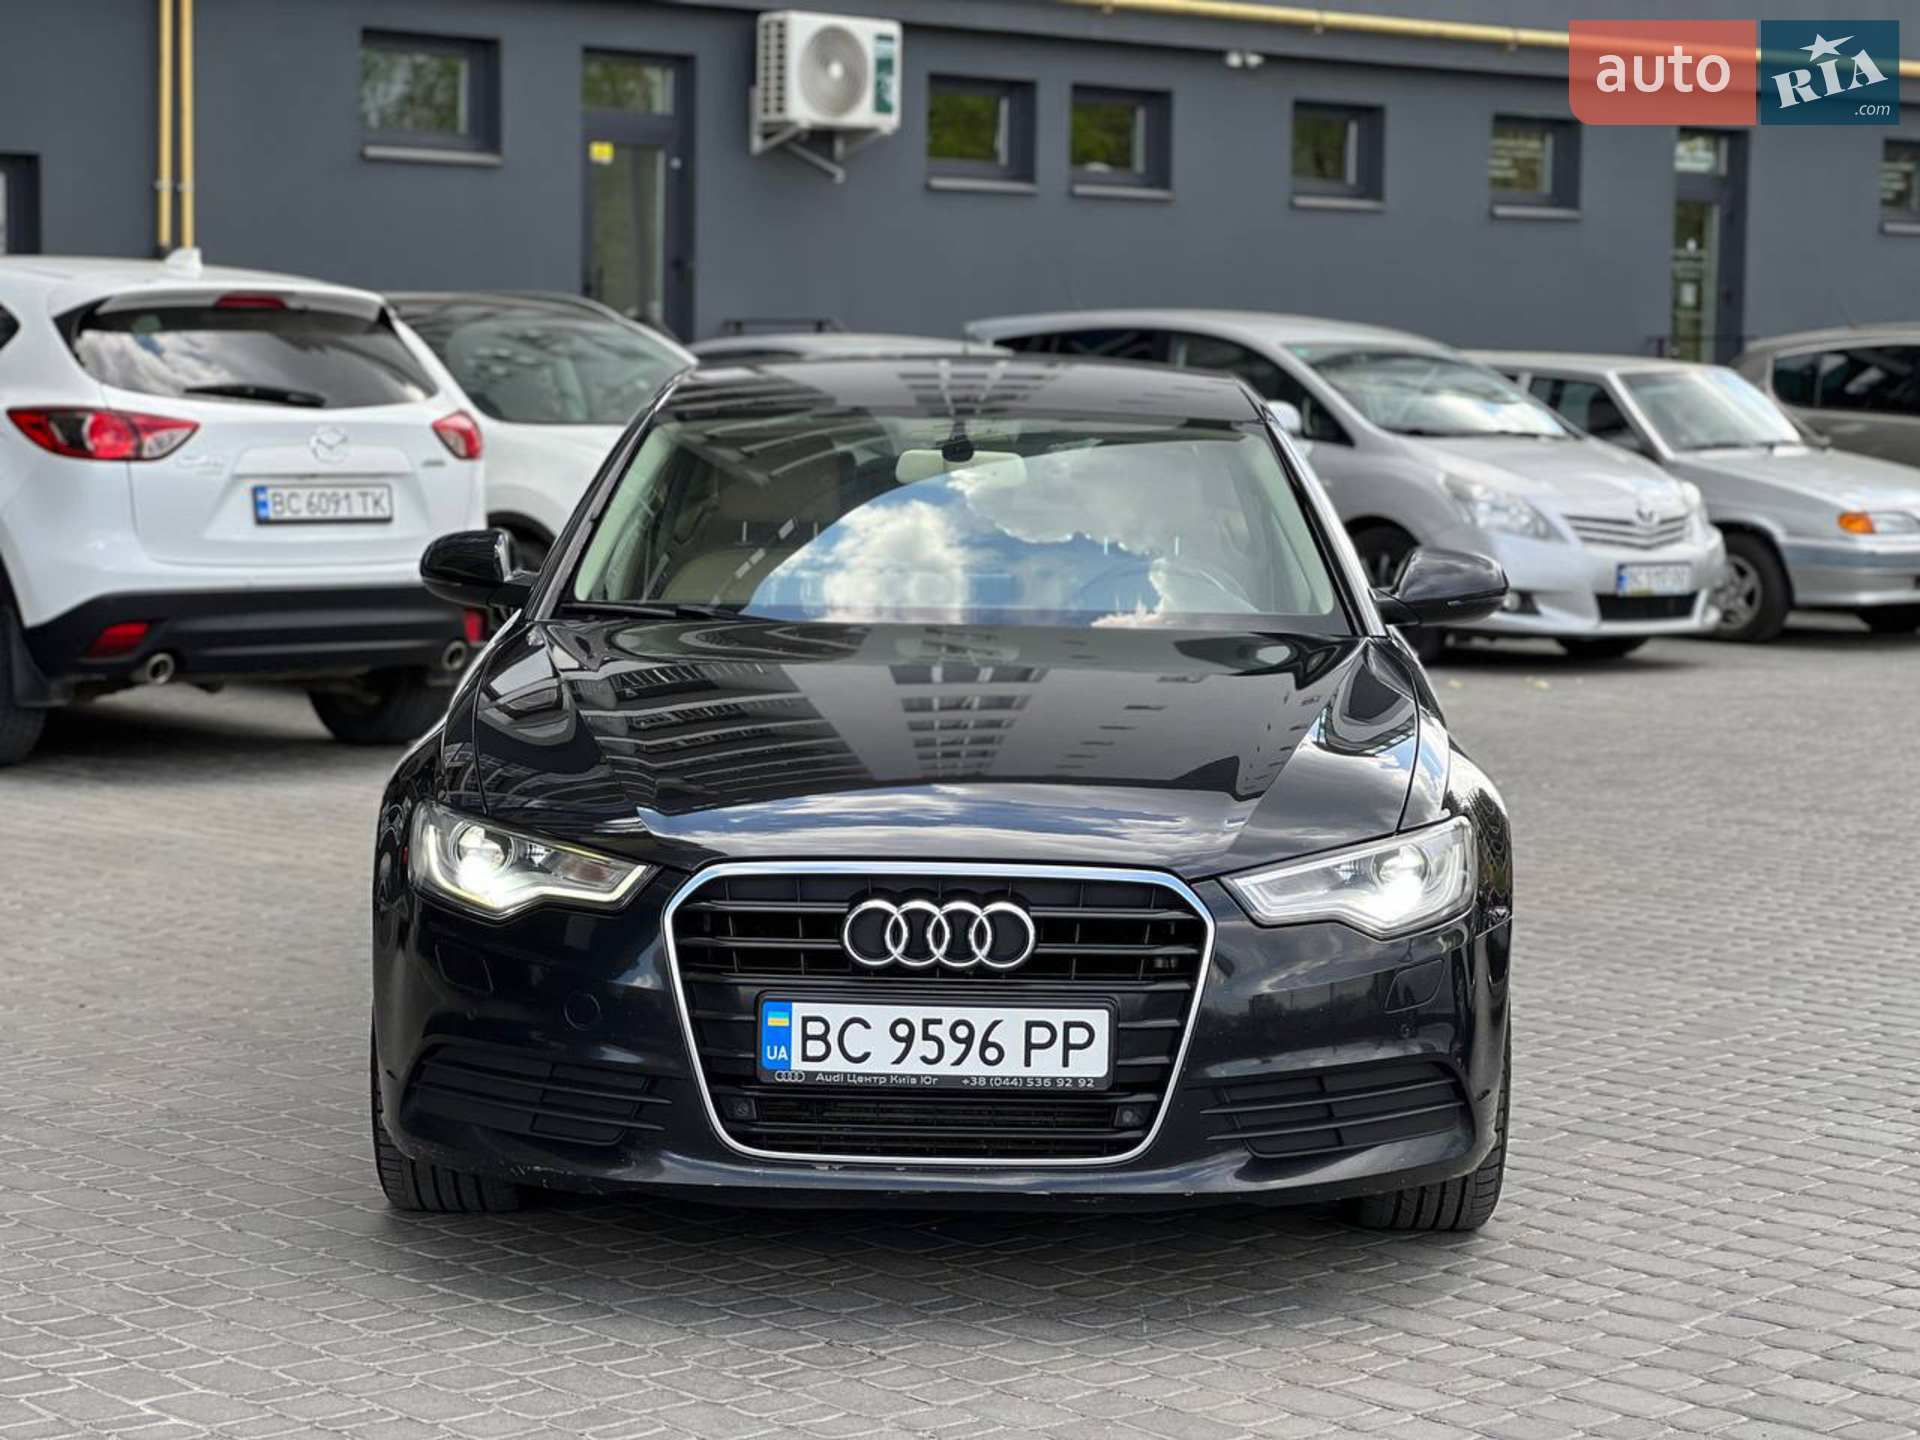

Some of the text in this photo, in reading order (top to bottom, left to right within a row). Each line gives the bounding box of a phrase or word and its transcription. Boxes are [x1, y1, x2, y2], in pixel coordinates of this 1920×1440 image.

[271, 491, 386, 515] BC 6091 TK
[800, 1016, 1096, 1068] BC 9596 PP
[767, 1045, 789, 1060] UA
[815, 1072, 938, 1085] Audi Центр Київ Юг
[961, 1076, 1095, 1088] +38 (044) 536 92 92
